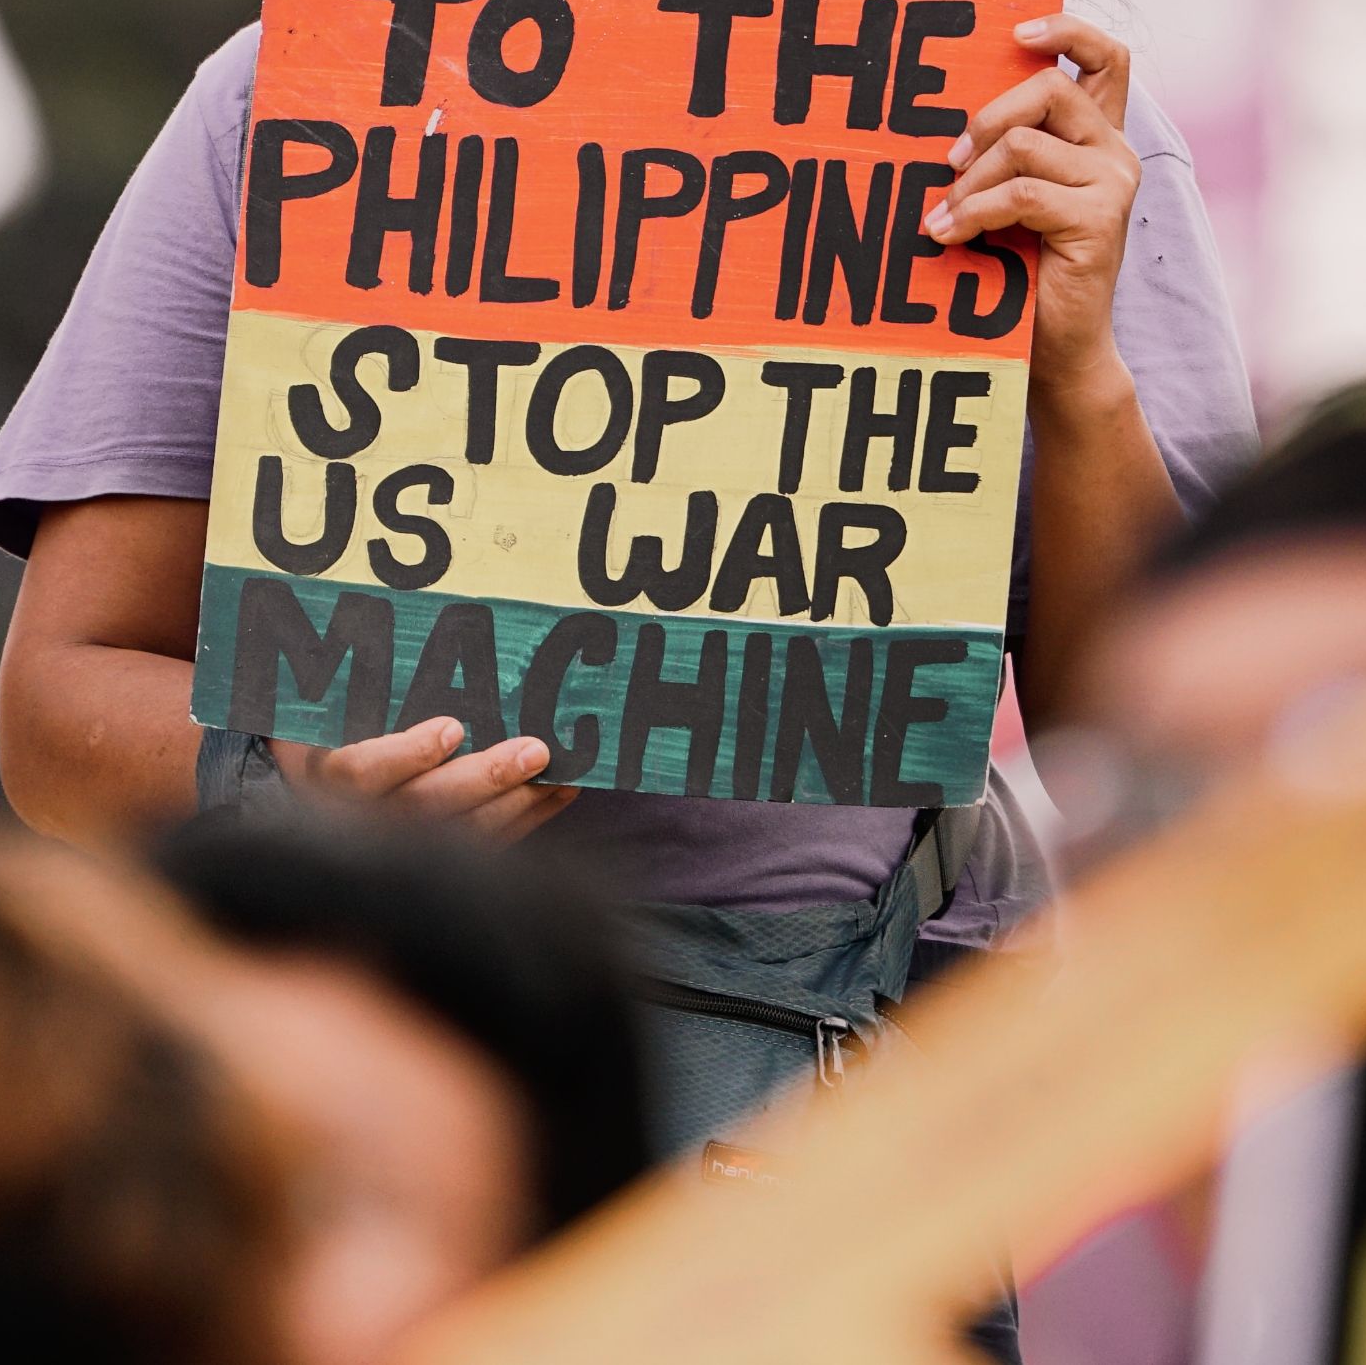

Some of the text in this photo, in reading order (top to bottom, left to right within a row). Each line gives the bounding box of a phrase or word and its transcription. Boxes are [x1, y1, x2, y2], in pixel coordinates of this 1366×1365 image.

[245, 119, 1030, 339] PHILIPPINES
[288, 325, 992, 494] STOP THE
[252, 455, 910, 627] US WAR
[228, 577, 969, 809] MACHINE
